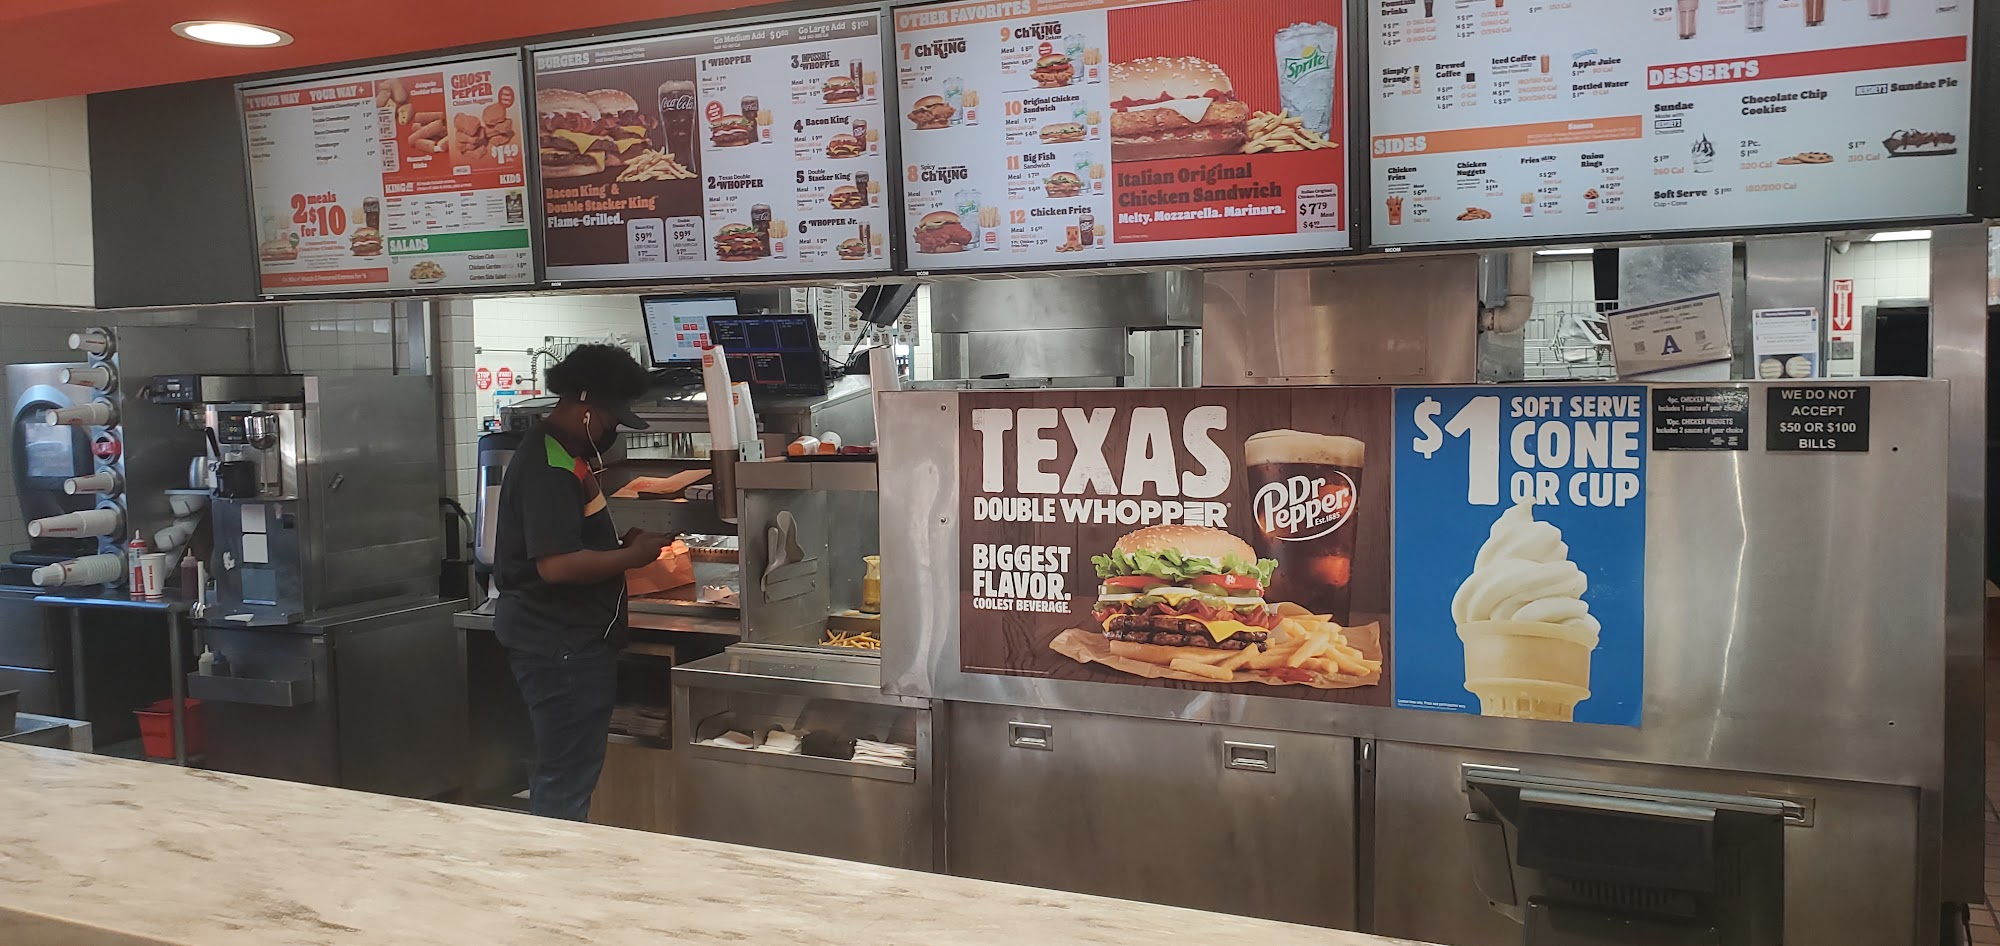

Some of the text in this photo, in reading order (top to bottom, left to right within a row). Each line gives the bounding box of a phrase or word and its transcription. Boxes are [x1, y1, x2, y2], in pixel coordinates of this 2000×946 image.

[900, 0, 1032, 29] OTHER FAVORITES
[1381, 7, 1408, 17] Drinks
[798, 21, 846, 35] Go Large Add
[1000, 27, 1010, 42] 9
[713, 31, 766, 45] Go Medium Add
[901, 43, 912, 60] 7
[1000, 47, 1015, 55] Meal
[536, 52, 590, 70] BURGERS
[708, 55, 752, 68] WHOPPER
[791, 54, 800, 69] 3
[800, 60, 840, 71] WHOPPER
[1286, 53, 1325, 79] Sprite
[1435, 60, 1466, 70] Brewed
[1491, 54, 1537, 65] Iced Coffee
[1571, 57, 1622, 69] Apple Juice
[1382, 67, 1409, 76] Simply
[1435, 70, 1462, 79] Coffee
[1648, 59, 1759, 86] DESSERTS
[450, 70, 492, 90] GHOST
[1382, 75, 1411, 84] Orange
[1572, 79, 1630, 91] Bottled Water
[1890, 80, 1936, 92] Sundae
[1937, 76, 1958, 89] Pie
[309, 85, 357, 102] YOUR WAY
[452, 82, 493, 100] PEPPER
[1741, 89, 1828, 105] Chocolate Chip
[254, 95, 280, 107] YOUR
[280, 92, 300, 104] WAY
[1005, 94, 1080, 117] 10 Original Chicken
[1654, 101, 1694, 112] Sundae
[1023, 104, 1056, 114] Sandwich
[1741, 104, 1787, 116] Cookies
[793, 115, 850, 133] 4 Bacon King
[1005, 118, 1020, 126] Meal
[1373, 135, 1427, 155] SIDES
[1006, 152, 1056, 171] 11 Big Fish
[1520, 157, 1540, 165] Fries
[1581, 152, 1605, 160] Onion
[1023, 162, 1051, 170] Sandwich
[1388, 166, 1418, 174] Chicken
[1457, 161, 1488, 169] Chicken
[1581, 160, 1603, 168] Rings
[796, 170, 805, 184] 5
[808, 172, 851, 182] Stacker King
[907, 163, 936, 182] 8 Spicy
[1117, 161, 1253, 188] Italian Original
[1388, 173, 1407, 181] Fries
[1457, 169, 1486, 177] Nuggets
[708, 175, 716, 190] 2
[716, 178, 764, 190] WHOPPER
[545, 183, 620, 199] Bacon King &
[1118, 181, 1282, 208] Chicken Sandwich
[1653, 188, 1708, 200] Soft Serve
[291, 190, 337, 224] 2 meals
[546, 195, 656, 214] Double Stacker King
[308, 204, 347, 237] $10
[547, 212, 625, 229] Flame-Grilled.
[1009, 204, 1092, 225] 12 Chicken Fries
[1118, 203, 1287, 225] Melty. Mozzarella. Marinara.
[300, 224, 317, 238] for
[798, 217, 858, 234] 6 WHOPPER Jr.
[389, 237, 430, 253] SALADS
[1661, 334, 1683, 356] A
[476, 371, 491, 379] STOP
[1781, 389, 1856, 400] WE DO NOT
[1702, 403, 1710, 412] of
[1790, 405, 1845, 417] ACCEPT
[1679, 426, 1684, 434] 2
[1703, 426, 1711, 434] of
[1779, 421, 1857, 434] $50 OR $100
[971, 404, 1231, 499] TEXAS
[1413, 395, 1641, 506] $1 SOFT SERVE
[1510, 419, 1640, 470] CONE
[1798, 438, 1837, 450] BILLS
[1287, 474, 1326, 507] Dr
[1510, 470, 1641, 508] OR CUP
[972, 496, 1229, 528] DOUBLE WHOPPER
[1253, 481, 1350, 534] Pepper
[972, 543, 1072, 573] BIGGEST
[972, 570, 1072, 601] FLAVOR.
[972, 596, 1072, 614] COOLEST BEVERAGE.
